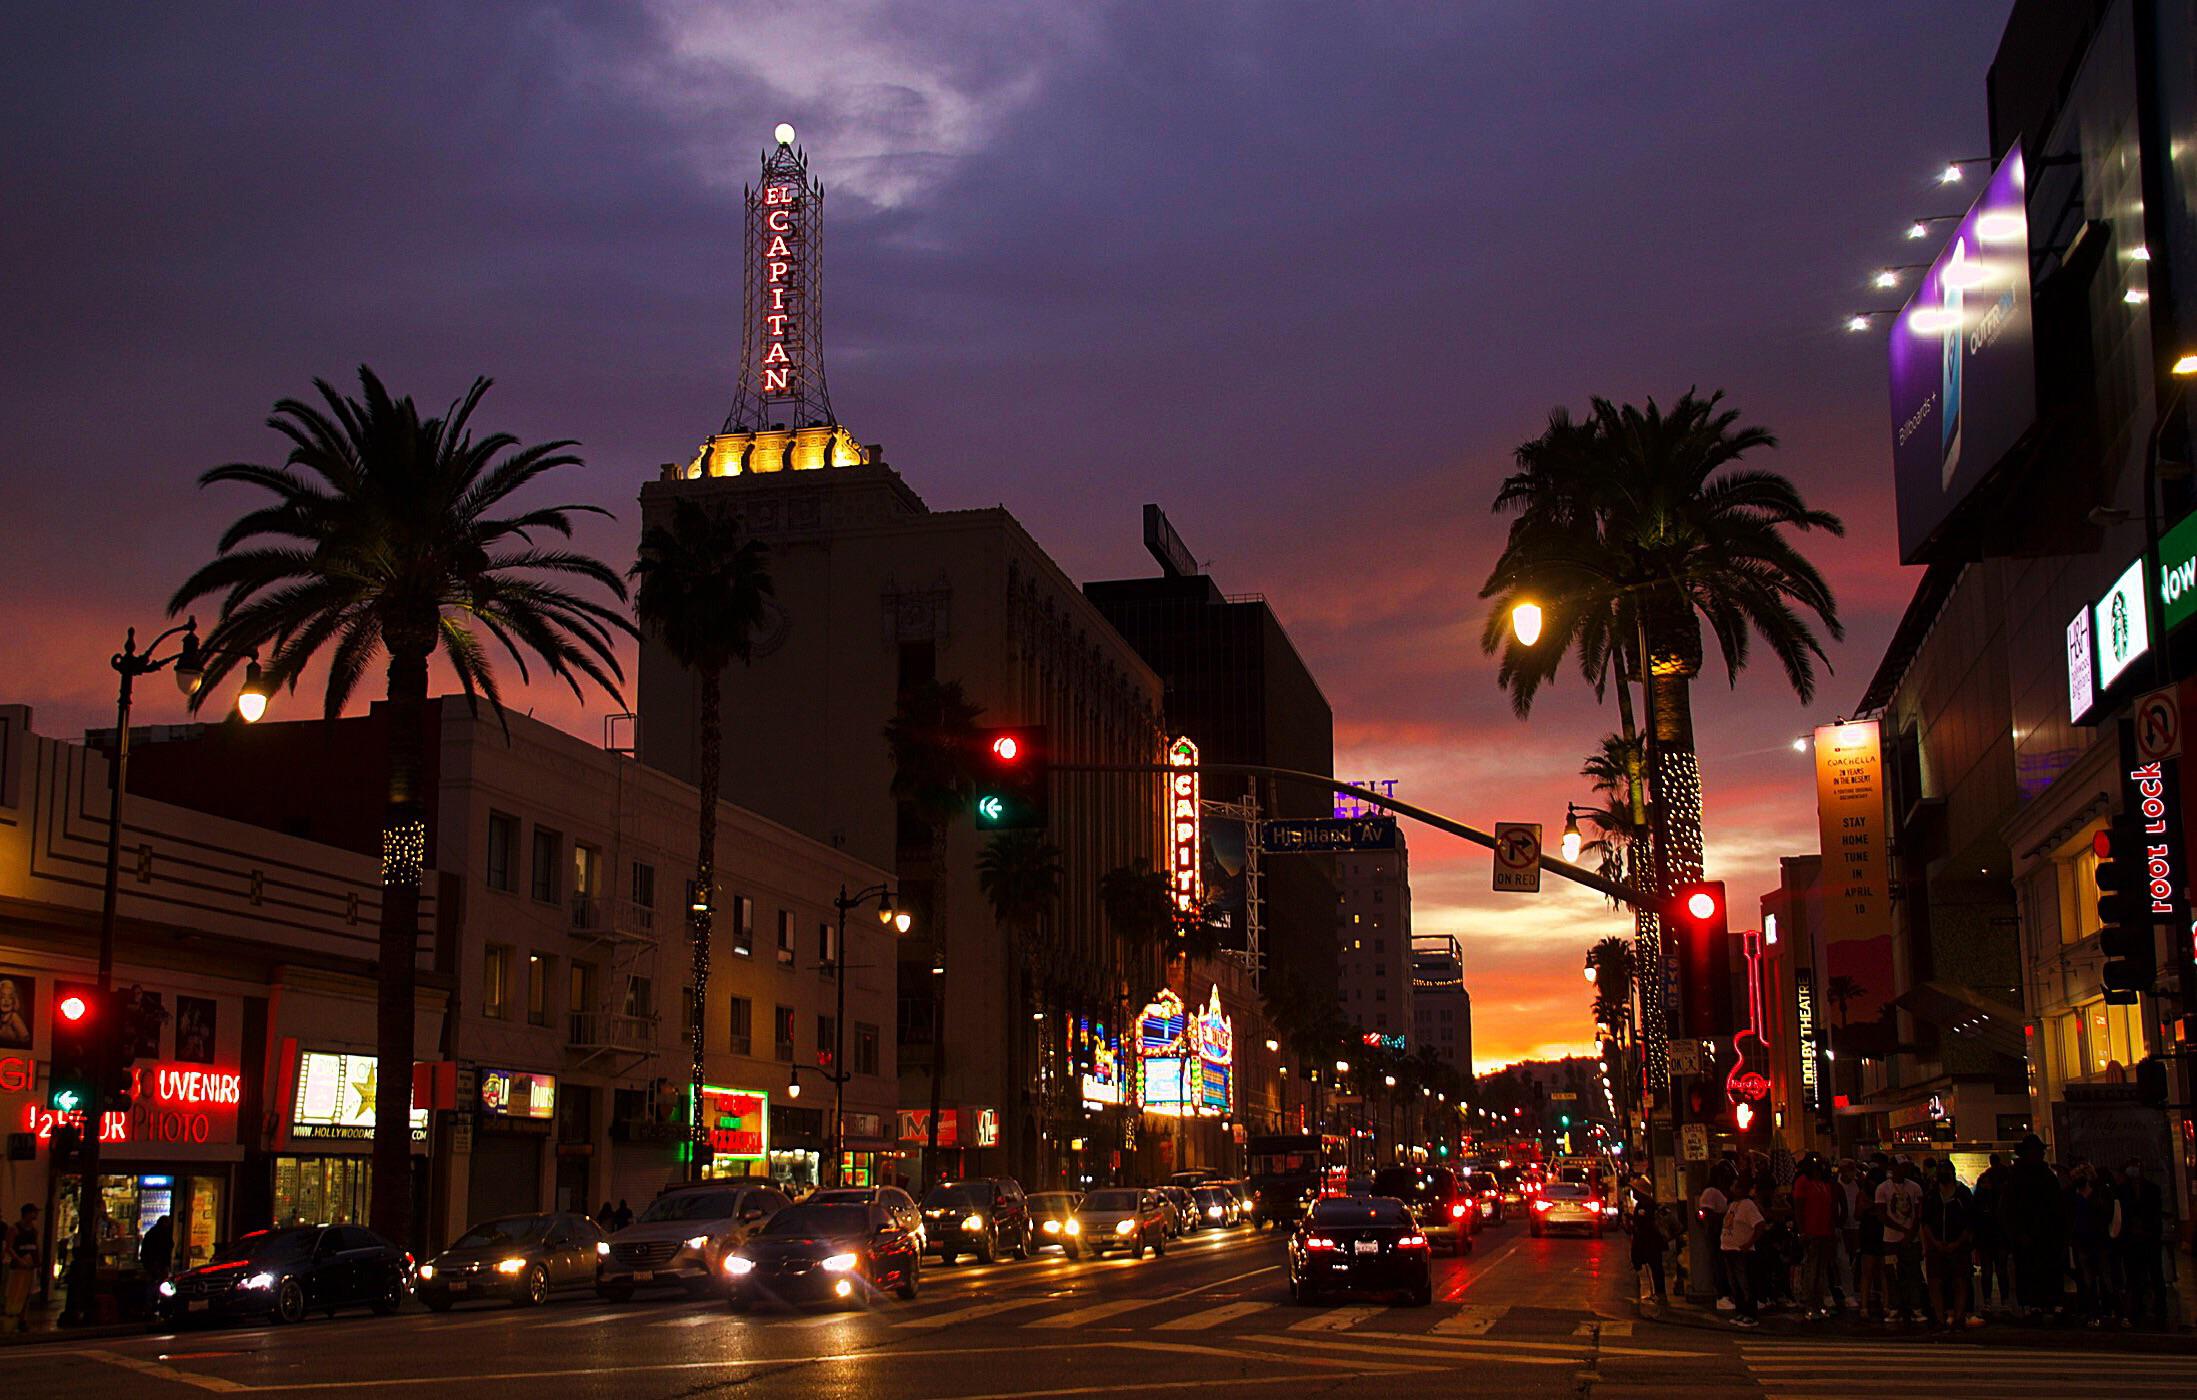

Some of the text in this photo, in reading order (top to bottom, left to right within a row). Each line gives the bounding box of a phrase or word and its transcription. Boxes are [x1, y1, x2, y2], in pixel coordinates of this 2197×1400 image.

[765, 187, 793, 205] EL
[765, 210, 791, 392] CAPITAN
[1827, 755, 1877, 768] COACHELLA
[1842, 816, 1866, 828] STAY
[1272, 824, 1383, 848] Highland Av
[1842, 834, 1869, 846] HOME
[1844, 851, 1869, 863] TUNE
[1497, 873, 1536, 886] ON RED
[1852, 869, 1863, 879] IN
[1844, 886, 1873, 897] APRIL
[1855, 903, 1866, 914] 10
[1798, 976, 1814, 1089] DOLBY THEATRE
[131, 1103, 209, 1143] PHOTO
